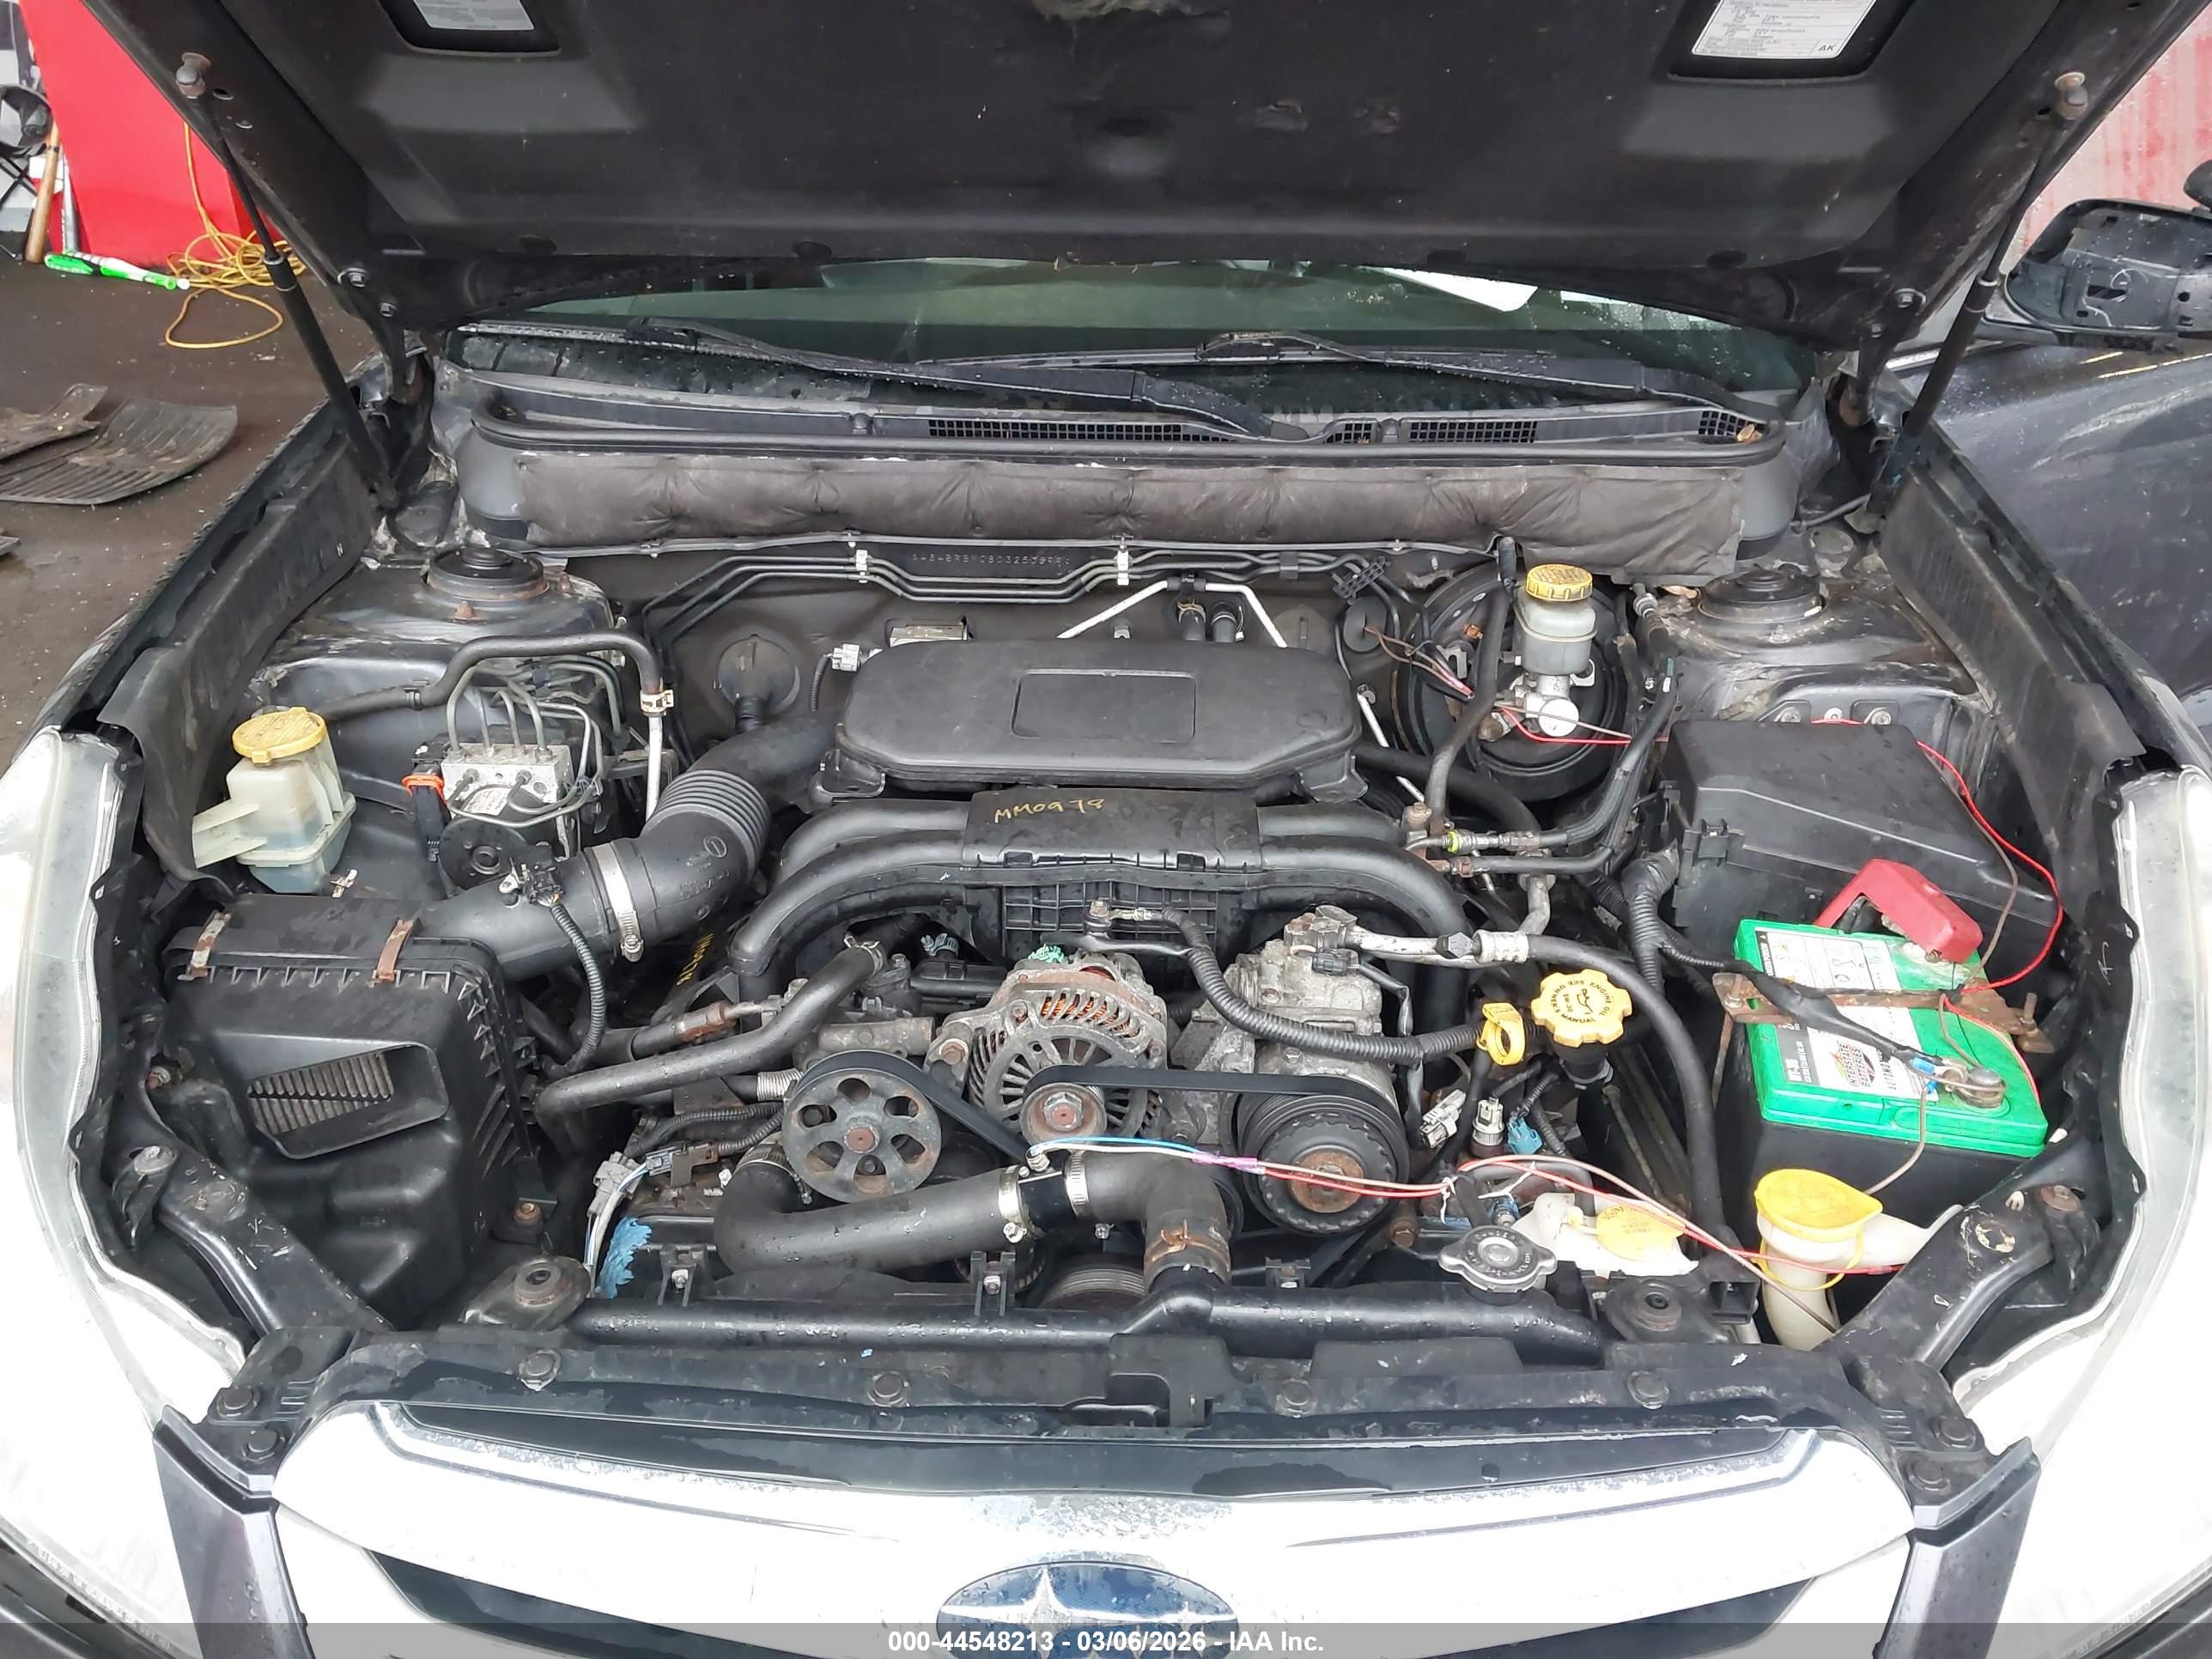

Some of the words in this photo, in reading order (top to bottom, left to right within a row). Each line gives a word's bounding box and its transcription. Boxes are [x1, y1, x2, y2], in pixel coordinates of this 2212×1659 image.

[1589, 981, 1612, 1005] ENGINE
[1560, 1014, 1596, 1024] MANUAL
[1599, 1007, 1611, 1017] OIL
[1839, 1042, 1859, 1088] INTERSTATE
[1852, 1047, 1870, 1089] BATTERIES
